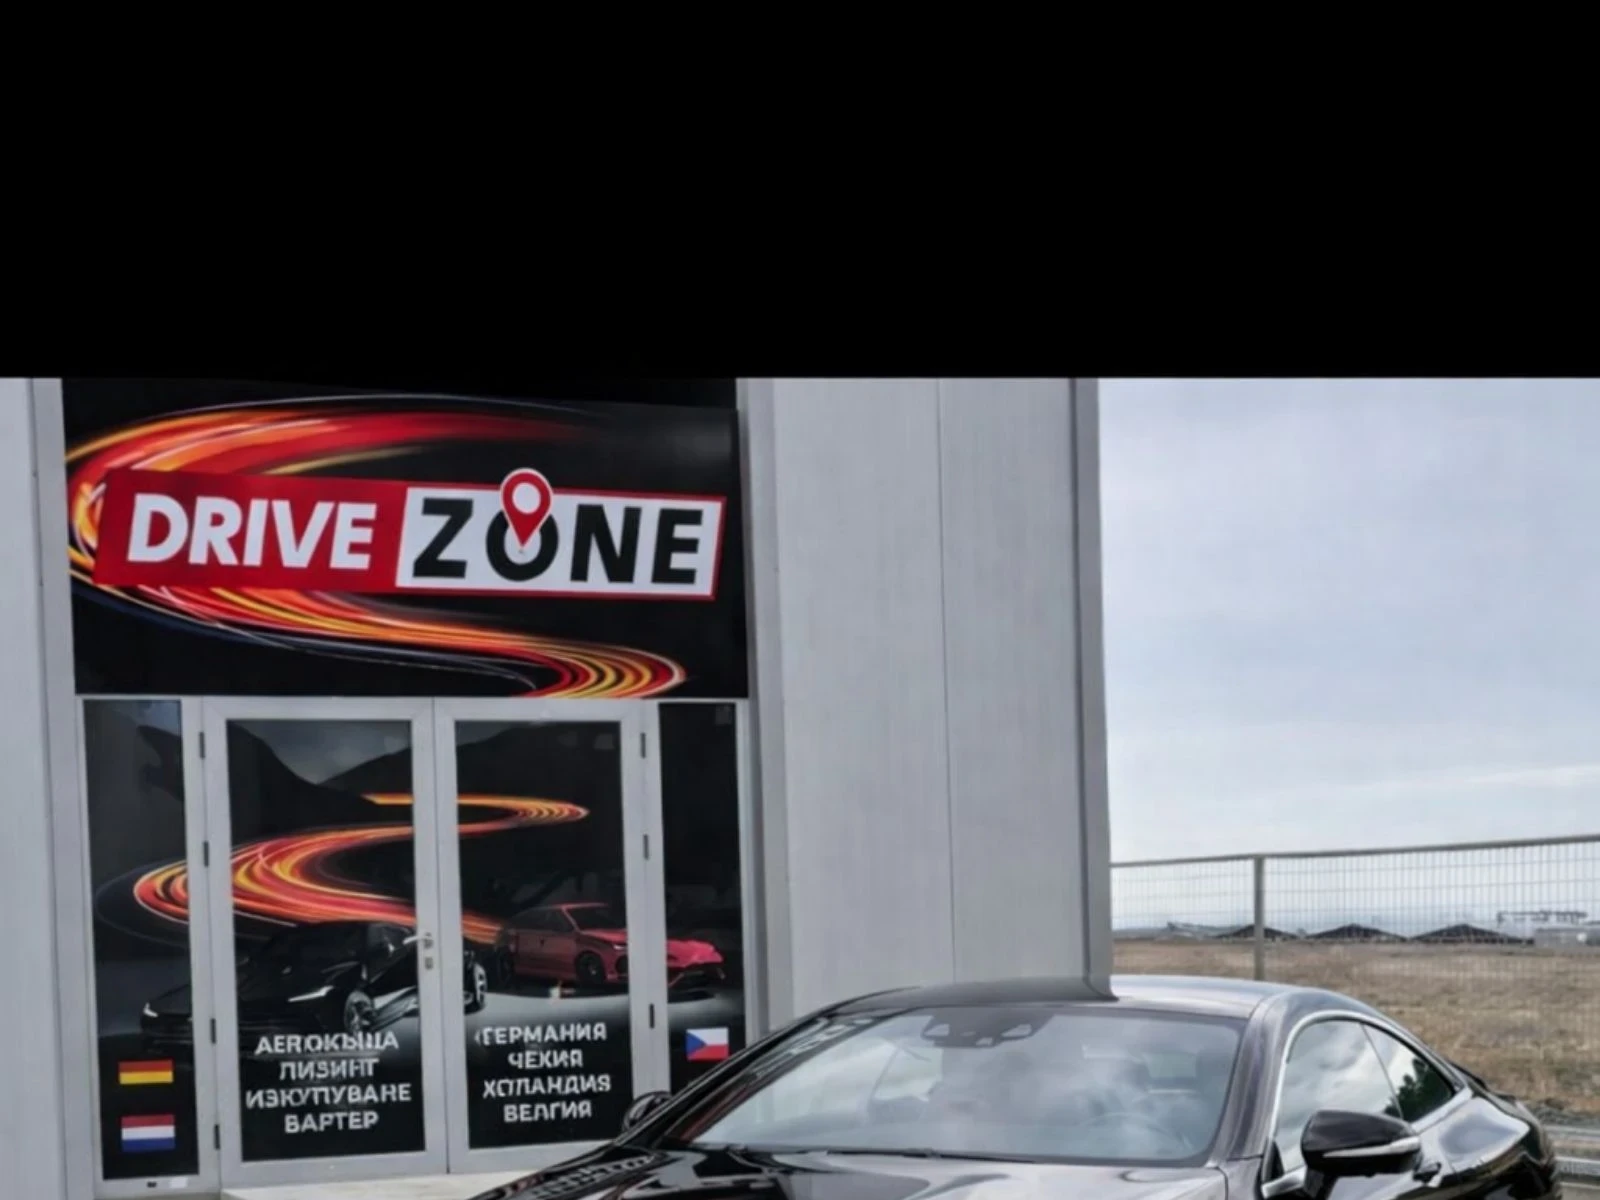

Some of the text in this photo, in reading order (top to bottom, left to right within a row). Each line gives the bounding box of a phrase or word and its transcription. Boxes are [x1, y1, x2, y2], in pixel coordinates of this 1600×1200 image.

[127, 492, 704, 583] DRIVE ZONE
[482, 1022, 607, 1046] ГЕРМАНИЯ
